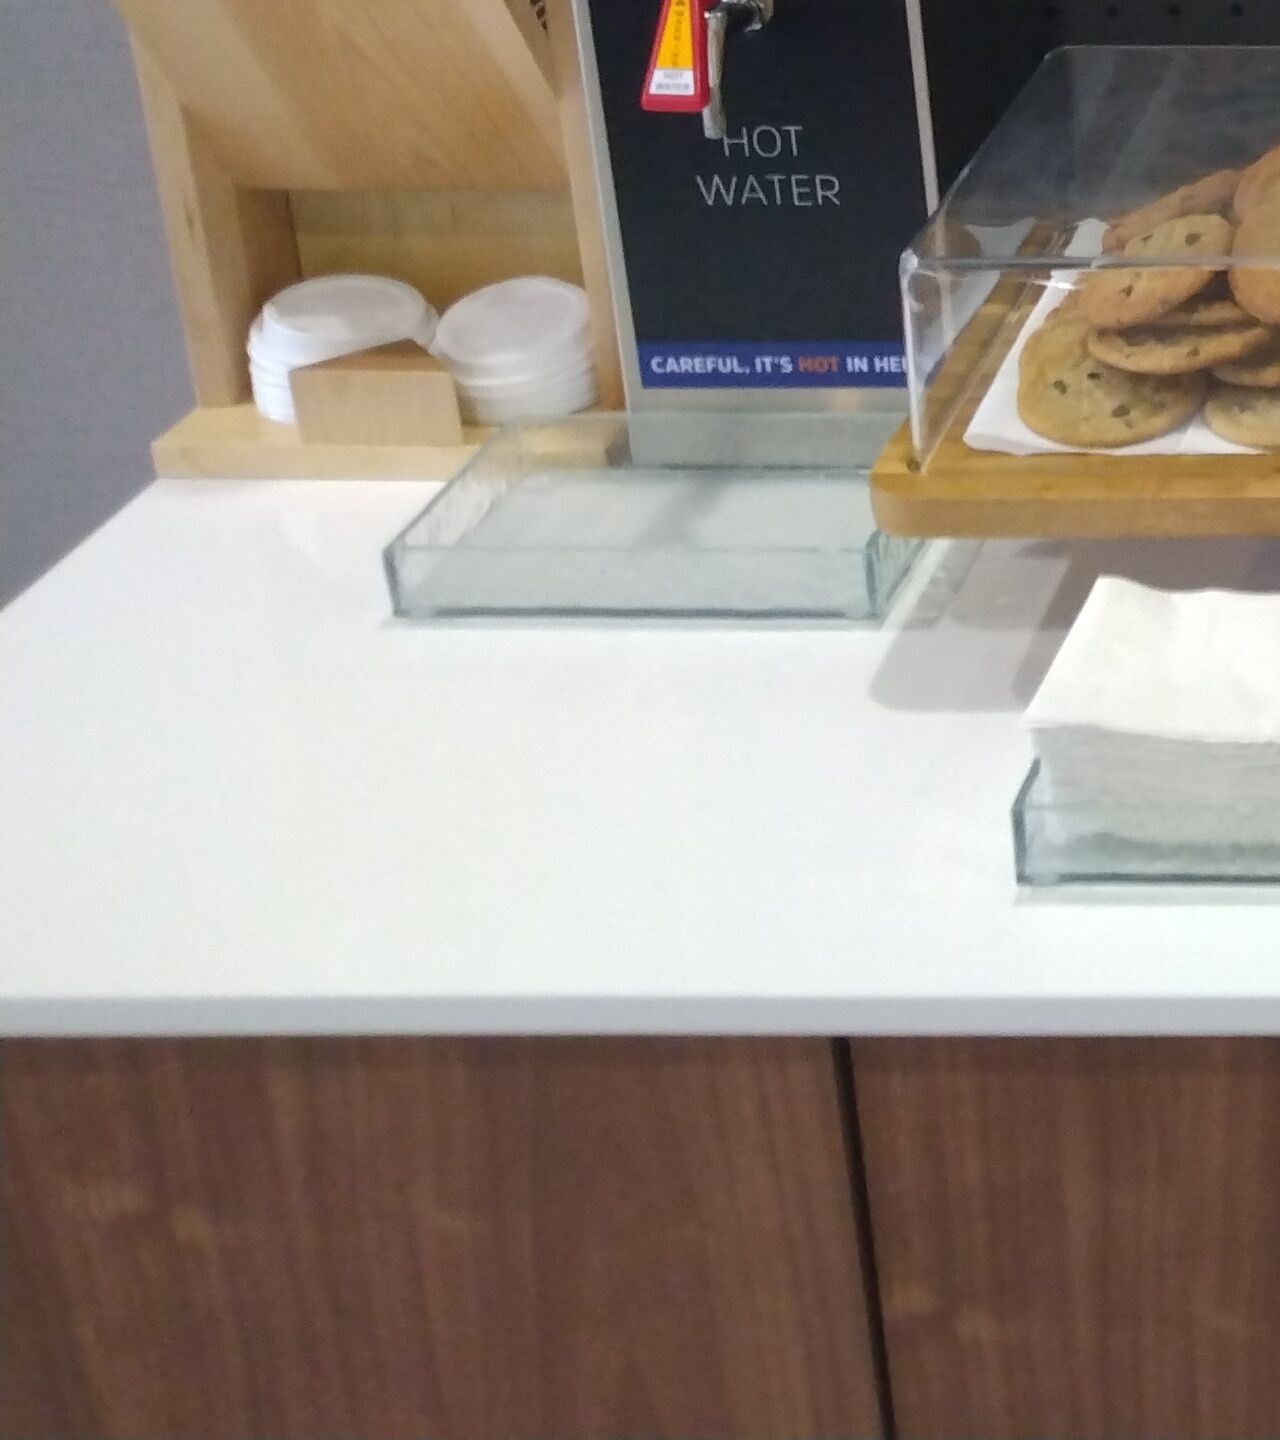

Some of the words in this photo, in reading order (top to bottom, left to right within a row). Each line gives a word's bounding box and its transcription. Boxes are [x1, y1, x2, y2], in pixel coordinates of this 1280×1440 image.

[722, 124, 803, 158] HOT
[696, 173, 841, 207] WATER
[650, 354, 751, 375] CAREFUL,
[798, 355, 839, 374] HOT
[845, 356, 869, 374] IN
